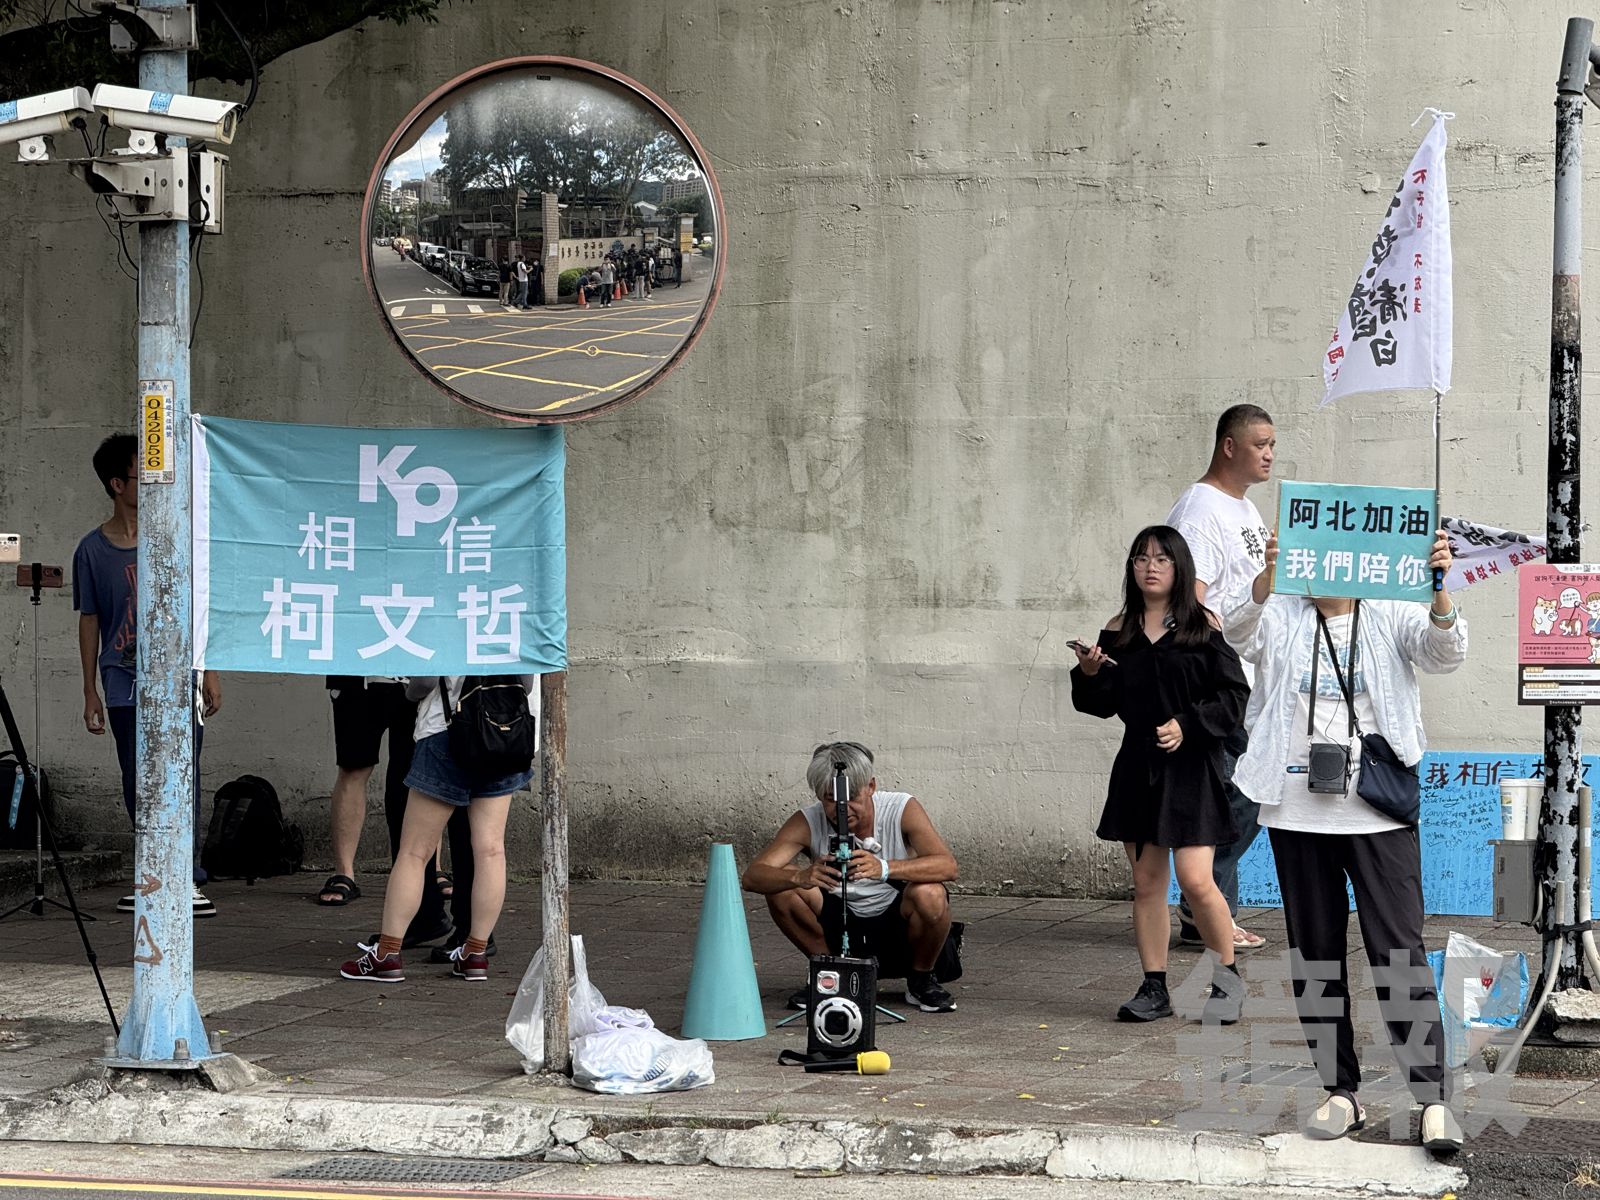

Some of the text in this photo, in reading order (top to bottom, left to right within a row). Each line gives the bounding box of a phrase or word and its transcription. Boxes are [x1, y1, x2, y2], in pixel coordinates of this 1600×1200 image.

[148, 398, 161, 467] 042056
[298, 511, 497, 574] 相信
[1288, 498, 1430, 537] 阿北加油
[1285, 547, 1428, 586] 我們陪你
[260, 577, 527, 664] 柯文哲
